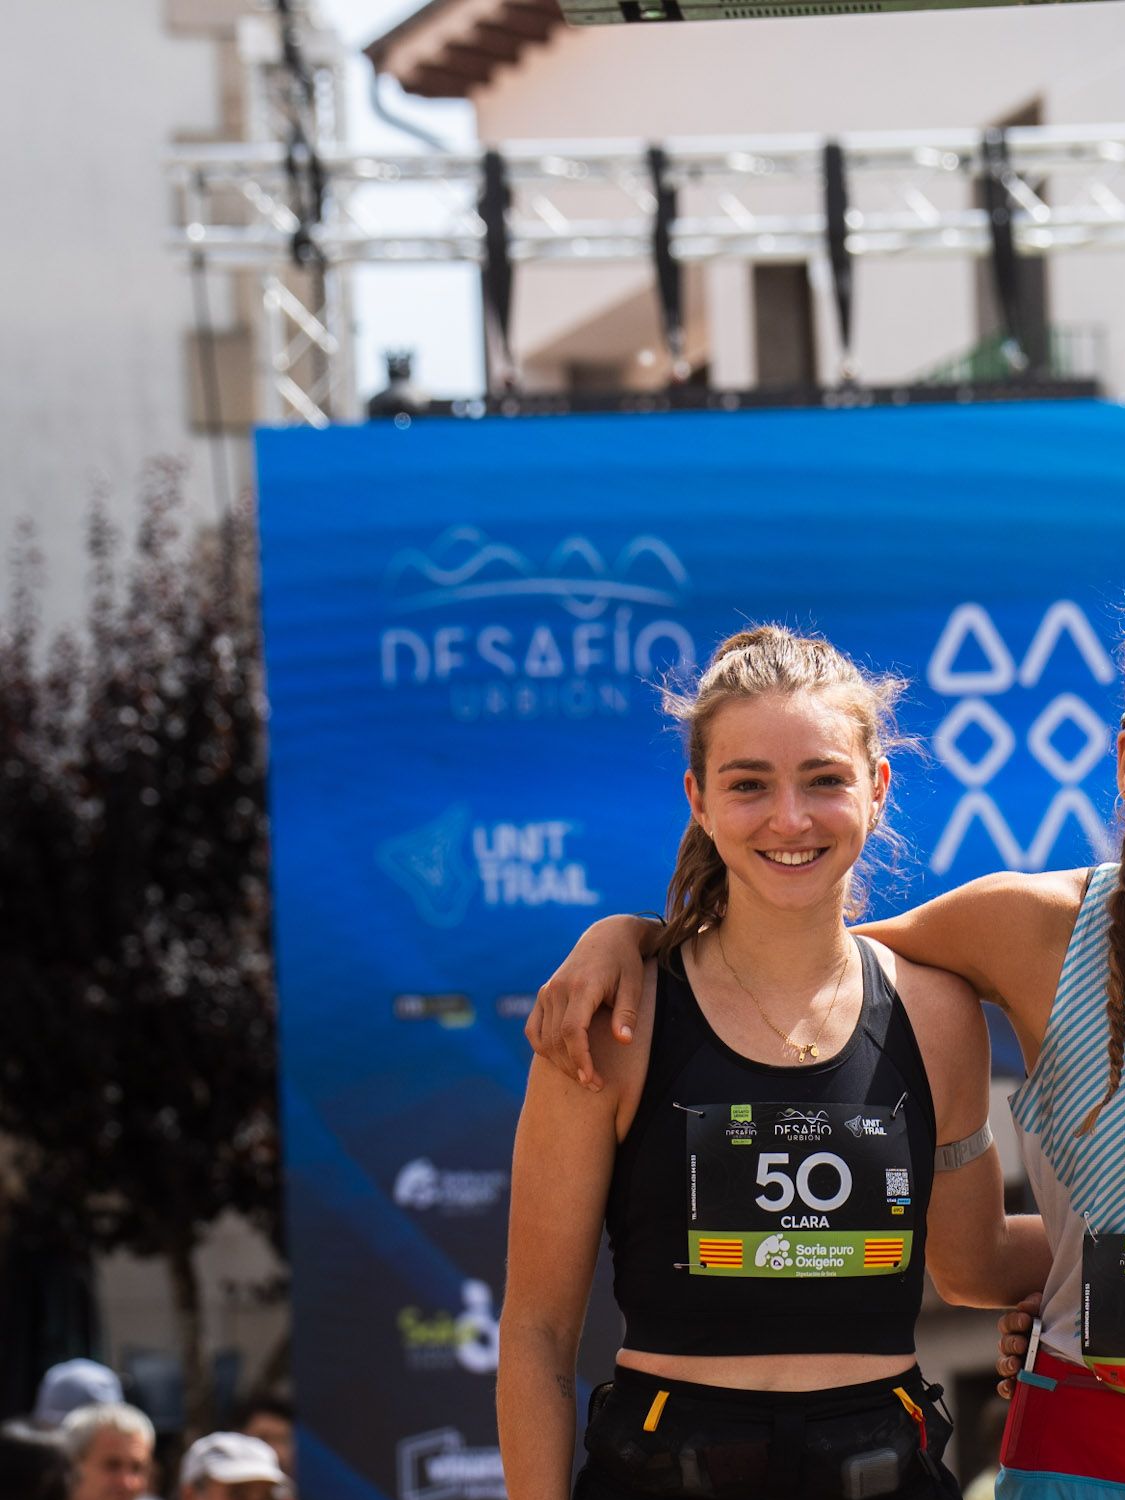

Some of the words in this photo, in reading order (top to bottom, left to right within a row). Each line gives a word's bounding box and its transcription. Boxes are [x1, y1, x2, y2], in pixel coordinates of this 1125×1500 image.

[774, 1121, 832, 1136] DESAFÍO
[862, 1118, 882, 1127] UNIT
[787, 1133, 821, 1142] URBIÓN
[863, 1127, 887, 1136] TRAIL
[755, 1151, 853, 1213] 50
[781, 1216, 830, 1229] CLARA
[796, 1243, 827, 1256] Soria
[829, 1246, 855, 1258] puro
[795, 1256, 844, 1271] Oxígeno
